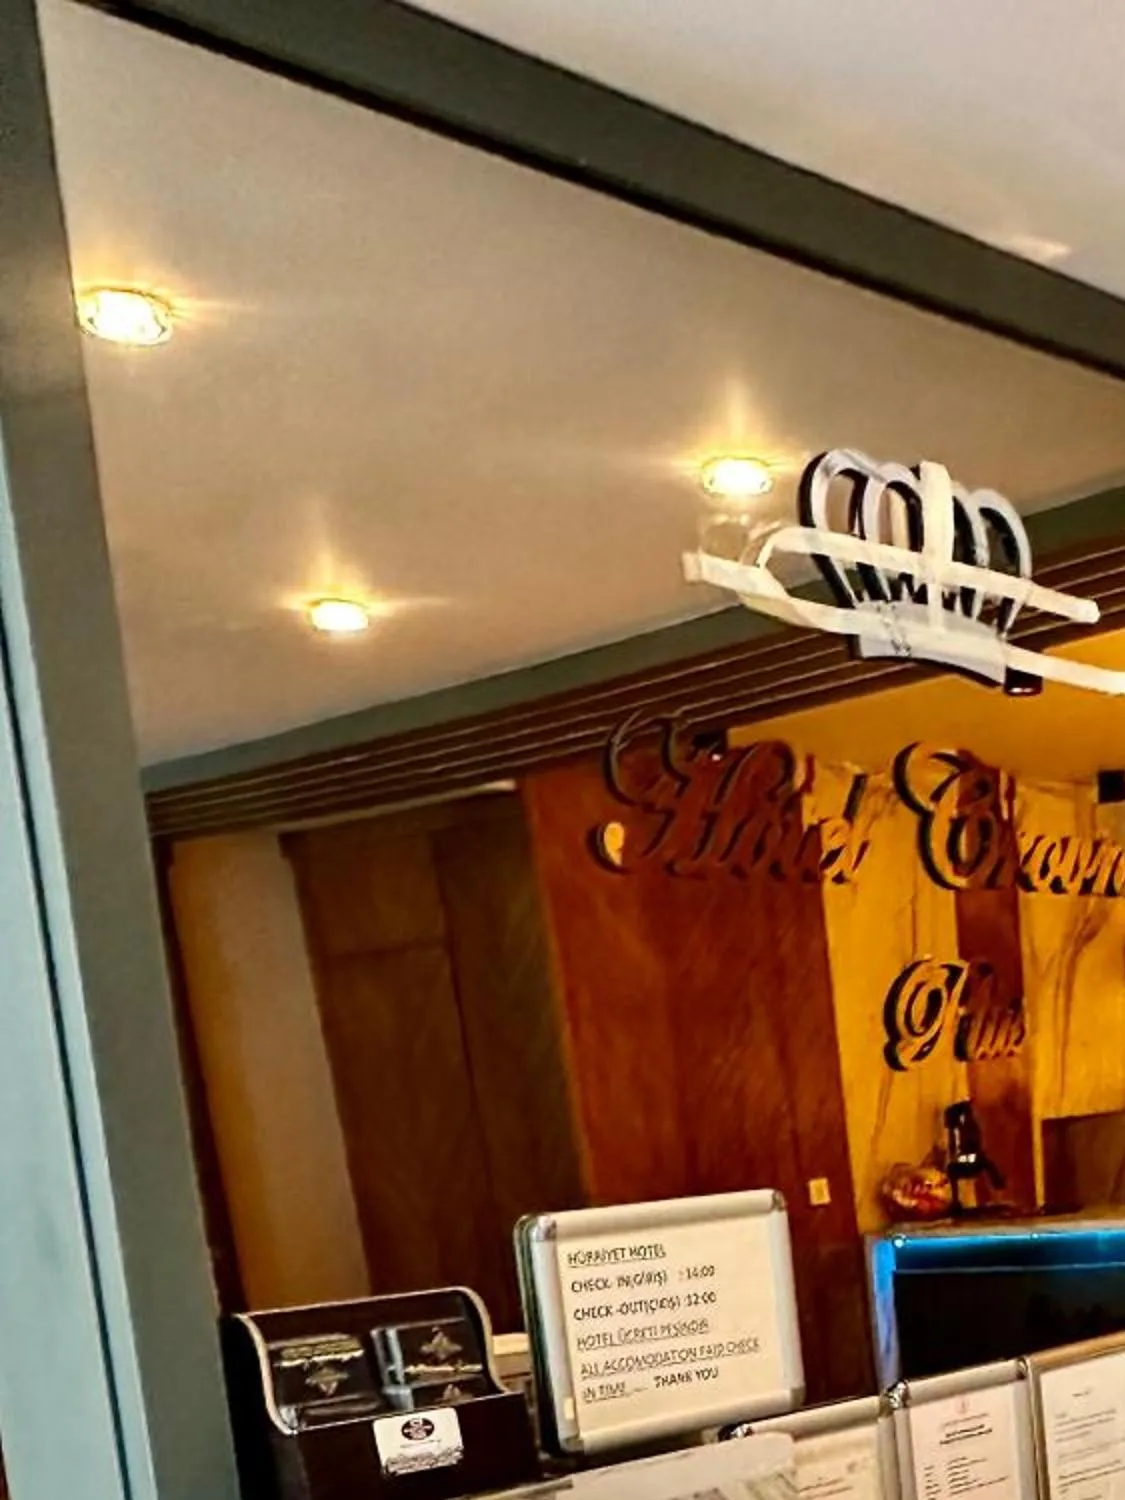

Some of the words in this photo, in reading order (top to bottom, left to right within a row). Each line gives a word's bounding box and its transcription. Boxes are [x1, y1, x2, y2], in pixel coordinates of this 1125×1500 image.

[629, 1243, 667, 1261] HOTEL
[577, 1332, 613, 1350] HOTEL
[653, 1370, 693, 1389] THANK
[695, 1366, 719, 1384] YOU
